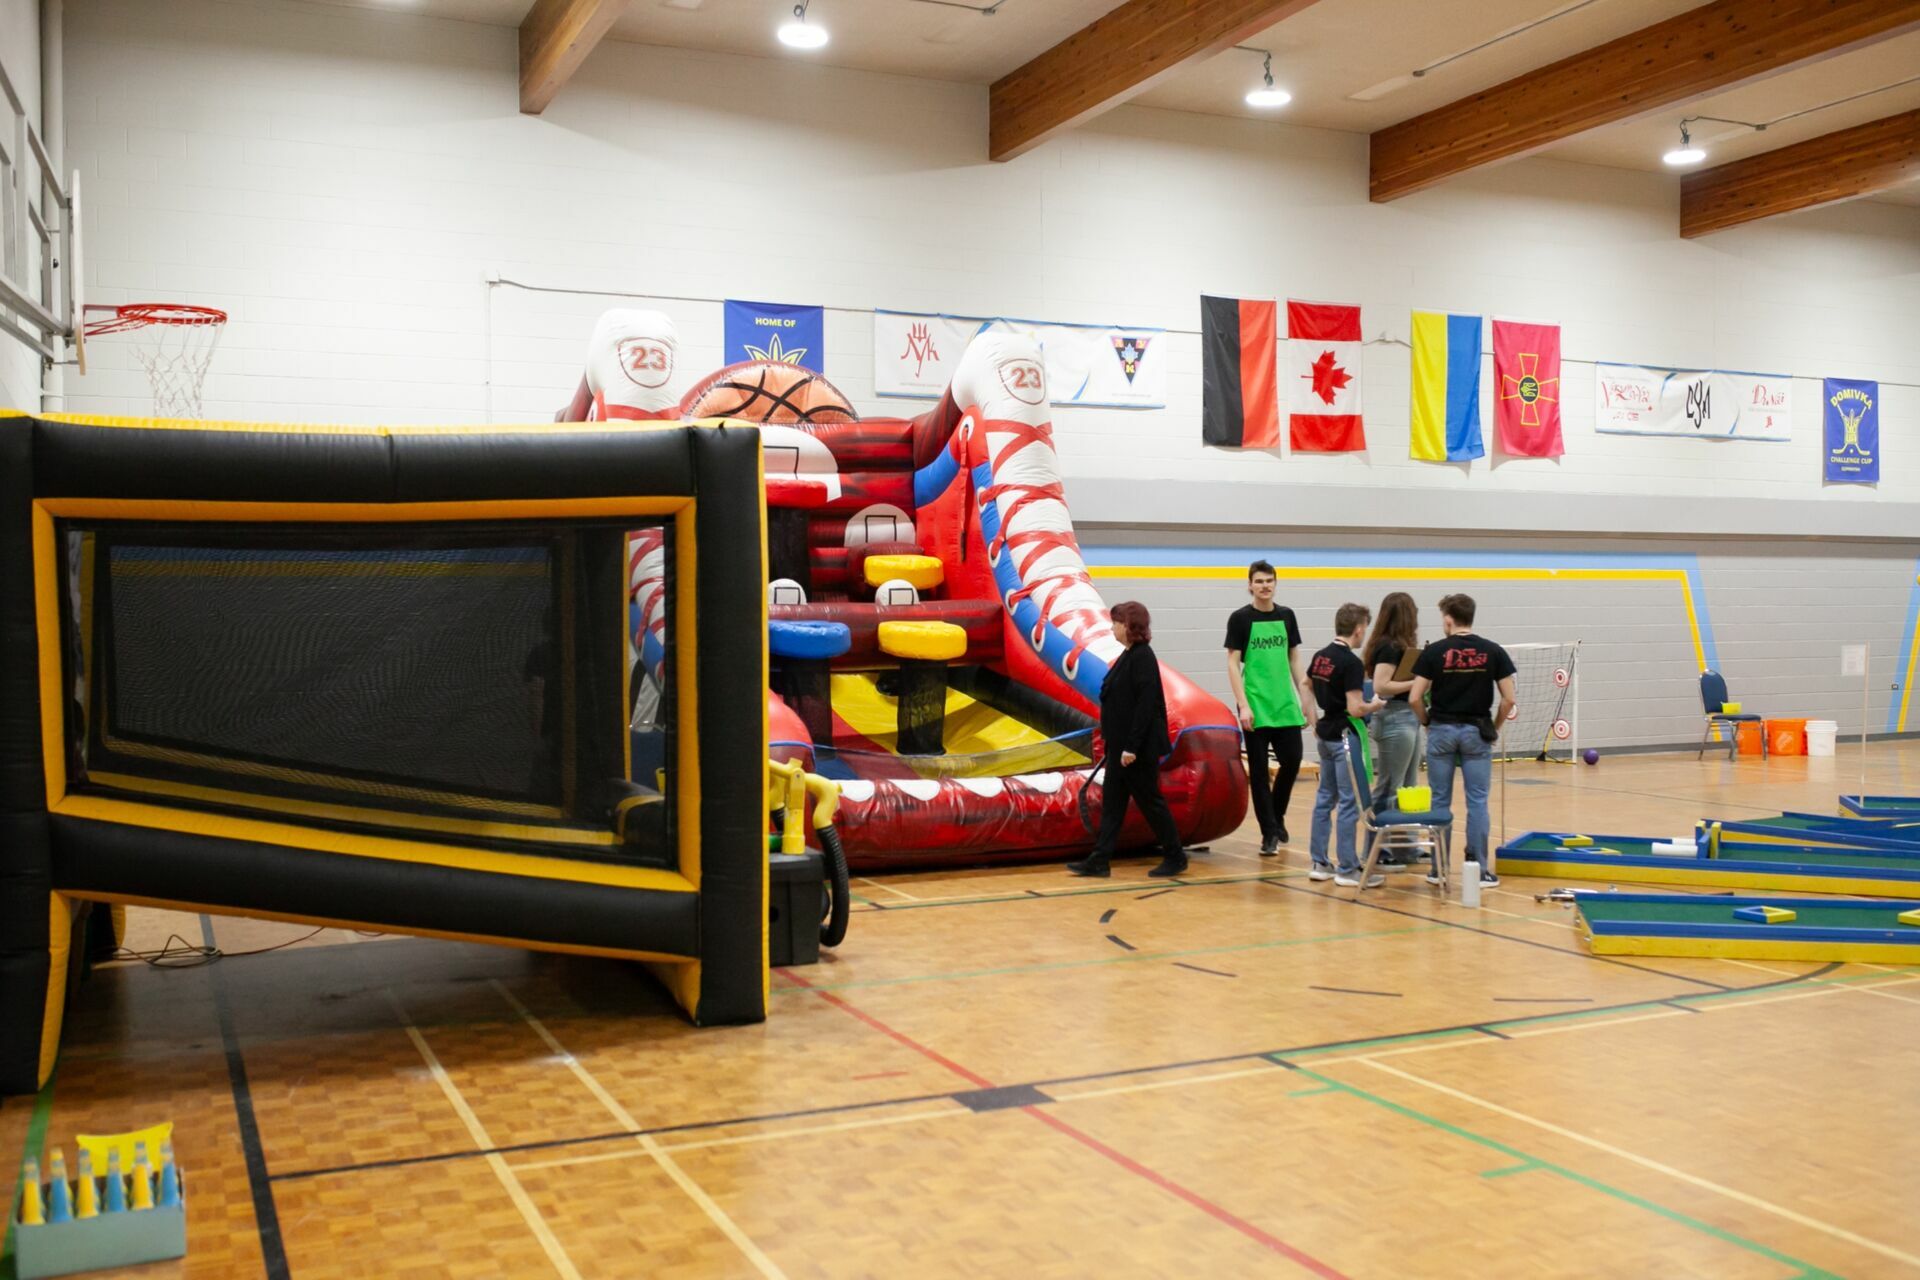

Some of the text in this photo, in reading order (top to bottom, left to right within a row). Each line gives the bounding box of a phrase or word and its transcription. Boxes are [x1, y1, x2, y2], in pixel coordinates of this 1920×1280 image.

[755, 317, 796, 328] HOME OF
[630, 344, 667, 372] 23
[1011, 366, 1042, 390] 23
[1829, 388, 1873, 410] DOMIVKA
[1830, 456, 1860, 464] CHALLENGE
